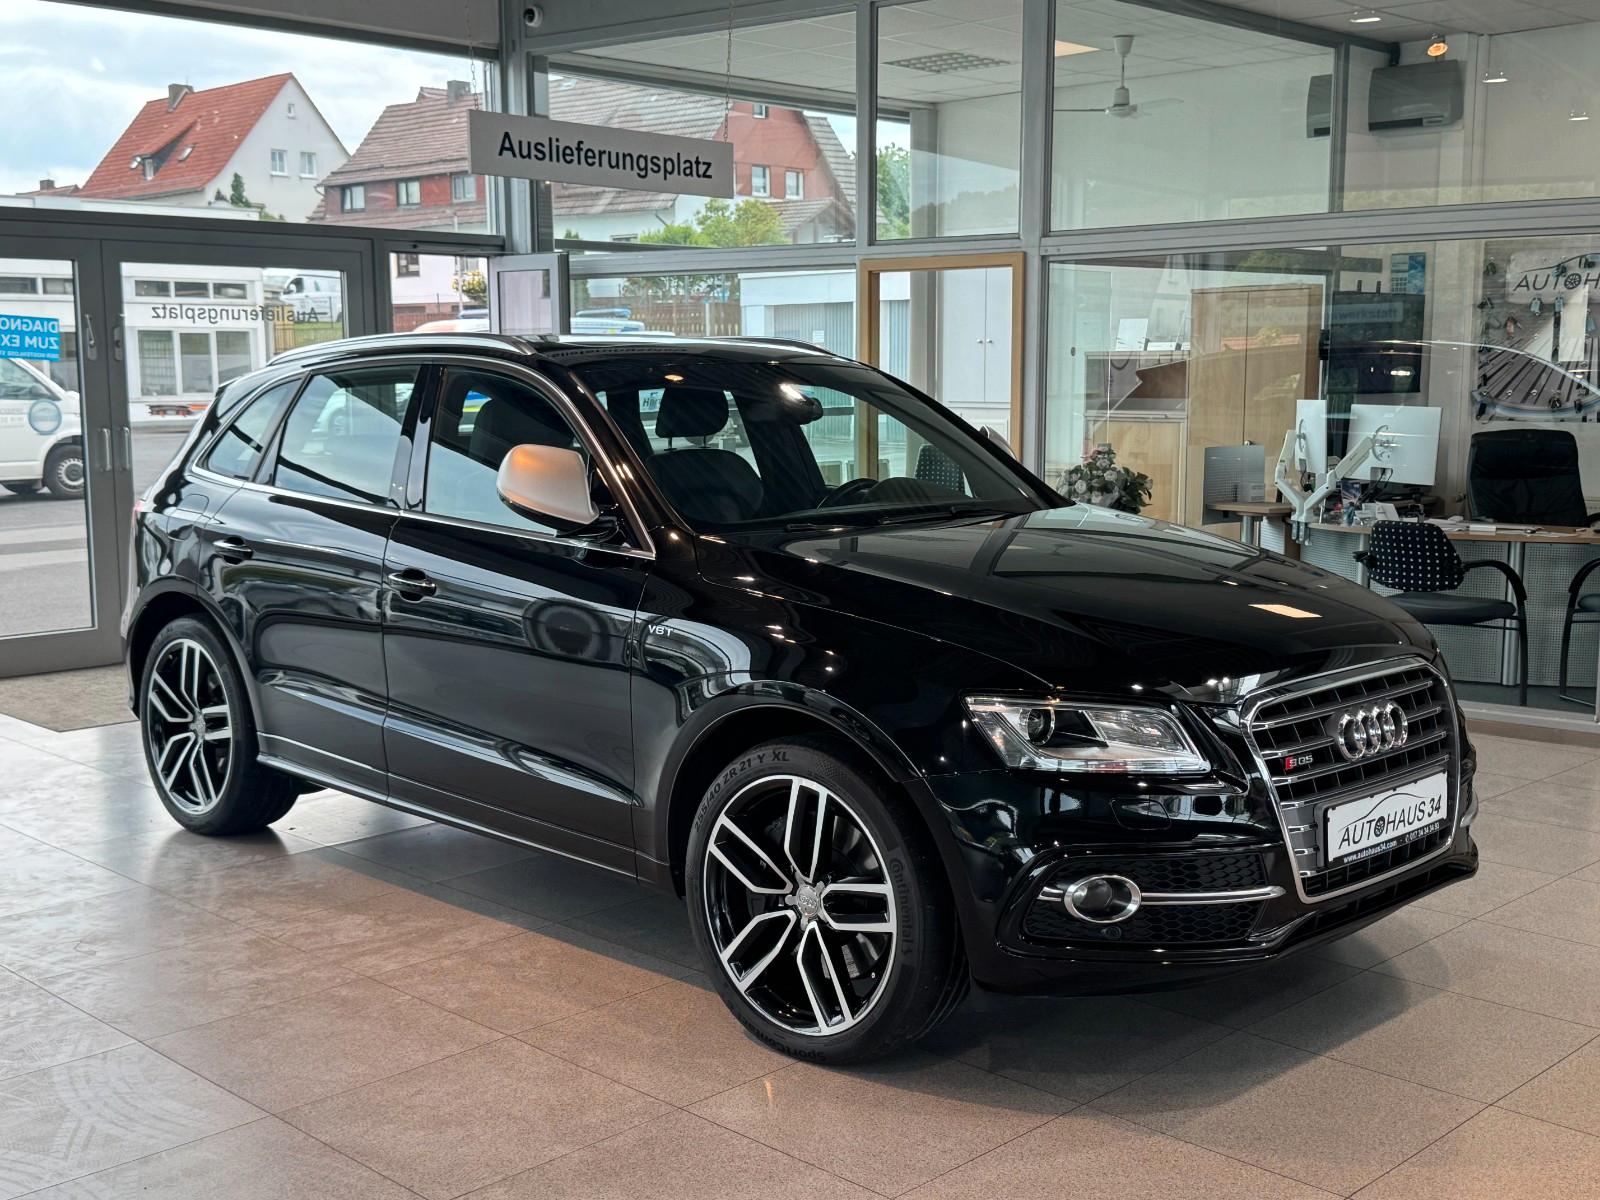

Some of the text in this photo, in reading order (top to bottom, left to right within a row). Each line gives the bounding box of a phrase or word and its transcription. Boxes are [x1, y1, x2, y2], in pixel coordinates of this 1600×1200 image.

[498, 131, 713, 180] Auslieferungsplatz
[694, 783, 721, 832] 255/40
[740, 758, 752, 771] 21
[756, 753, 766, 763] Y
[772, 750, 790, 762] XL
[1338, 794, 1442, 849] AUTOHAUS 34
[1343, 840, 1397, 863] www.autohaus34.com
[889, 857, 914, 943] Continental
